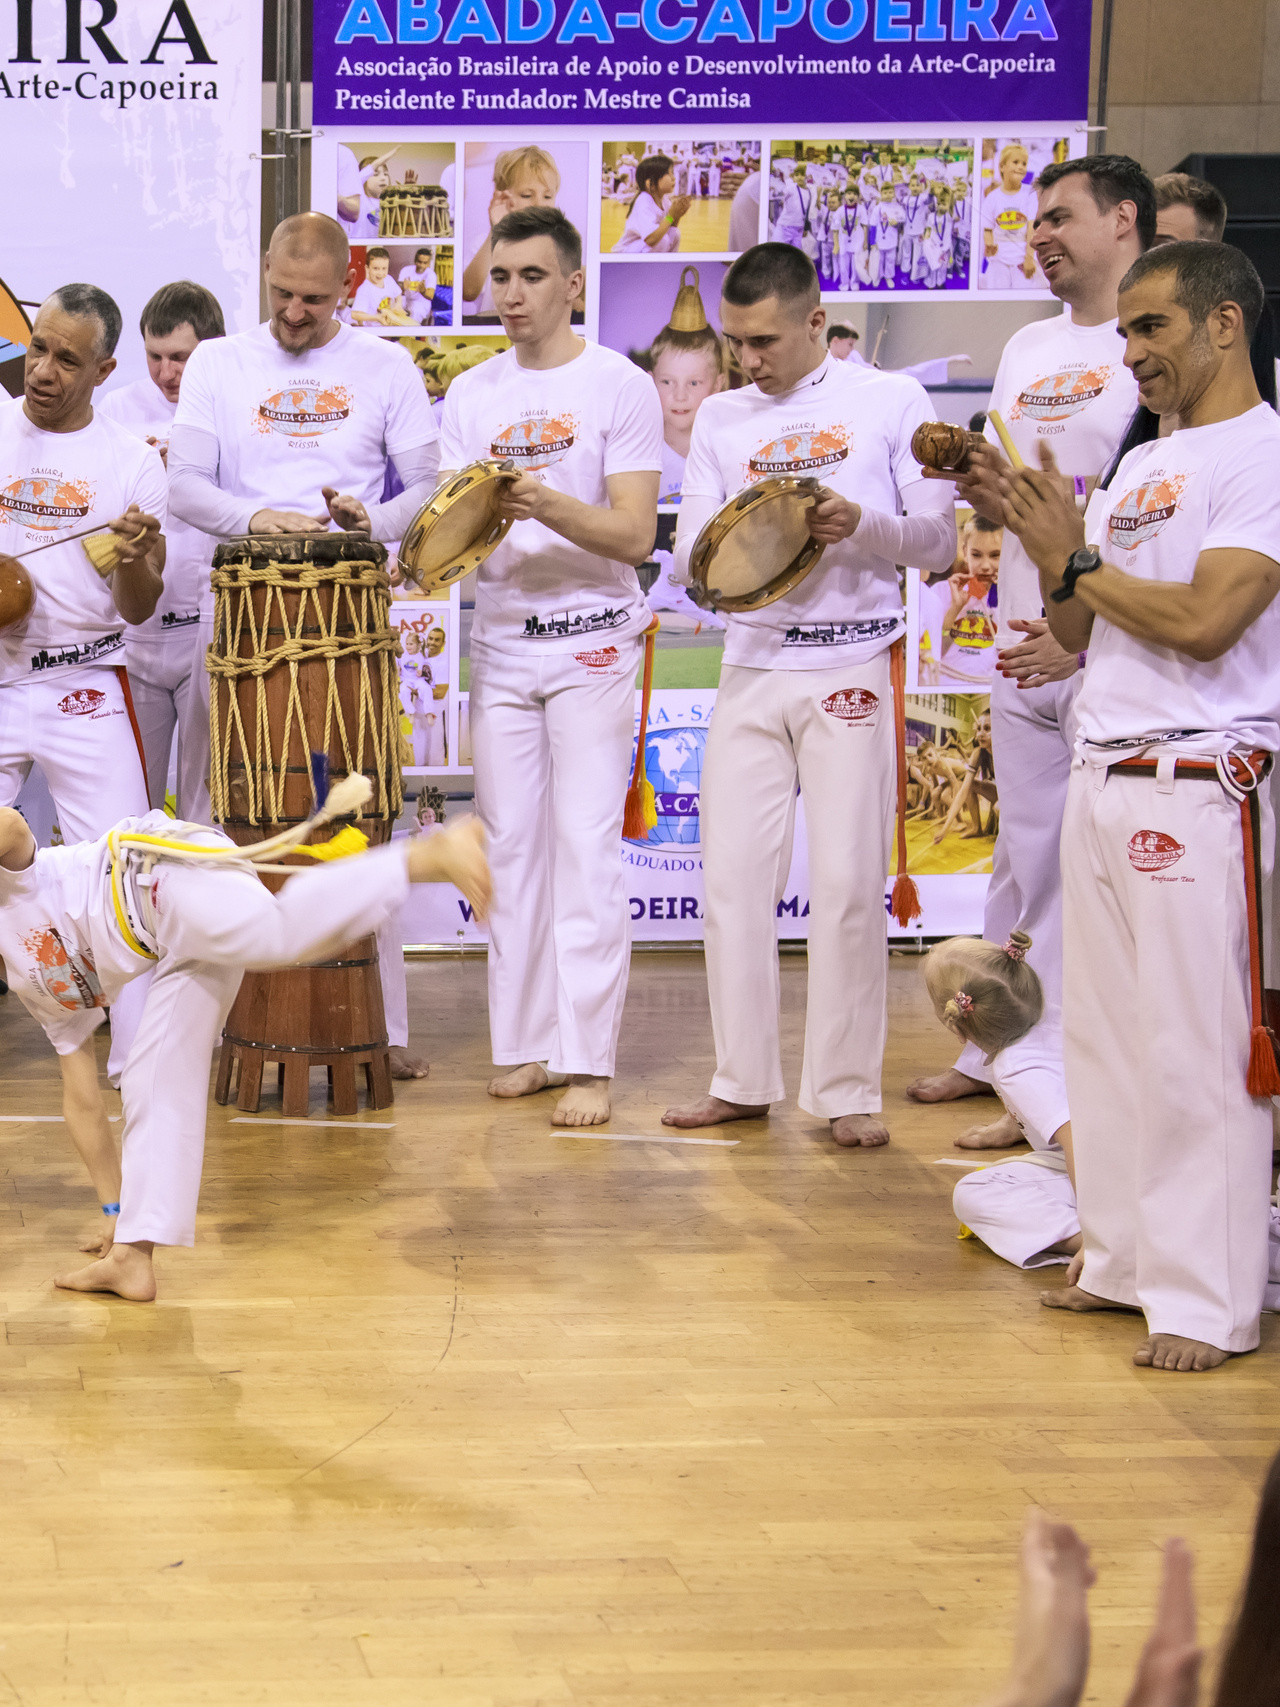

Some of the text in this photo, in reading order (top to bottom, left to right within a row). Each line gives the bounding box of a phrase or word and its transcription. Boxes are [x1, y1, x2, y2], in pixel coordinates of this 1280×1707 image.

[335, 52, 1056, 82] Associação Brasileira de Apoio e Desenvolvimento da Arte-Capoeira
[334, 87, 752, 110] Presidente Fundador: Mestre Camisa
[0, 498, 83, 516] ABADÁ-CAPOEIRA
[620, 849, 695, 872] RADUADO
